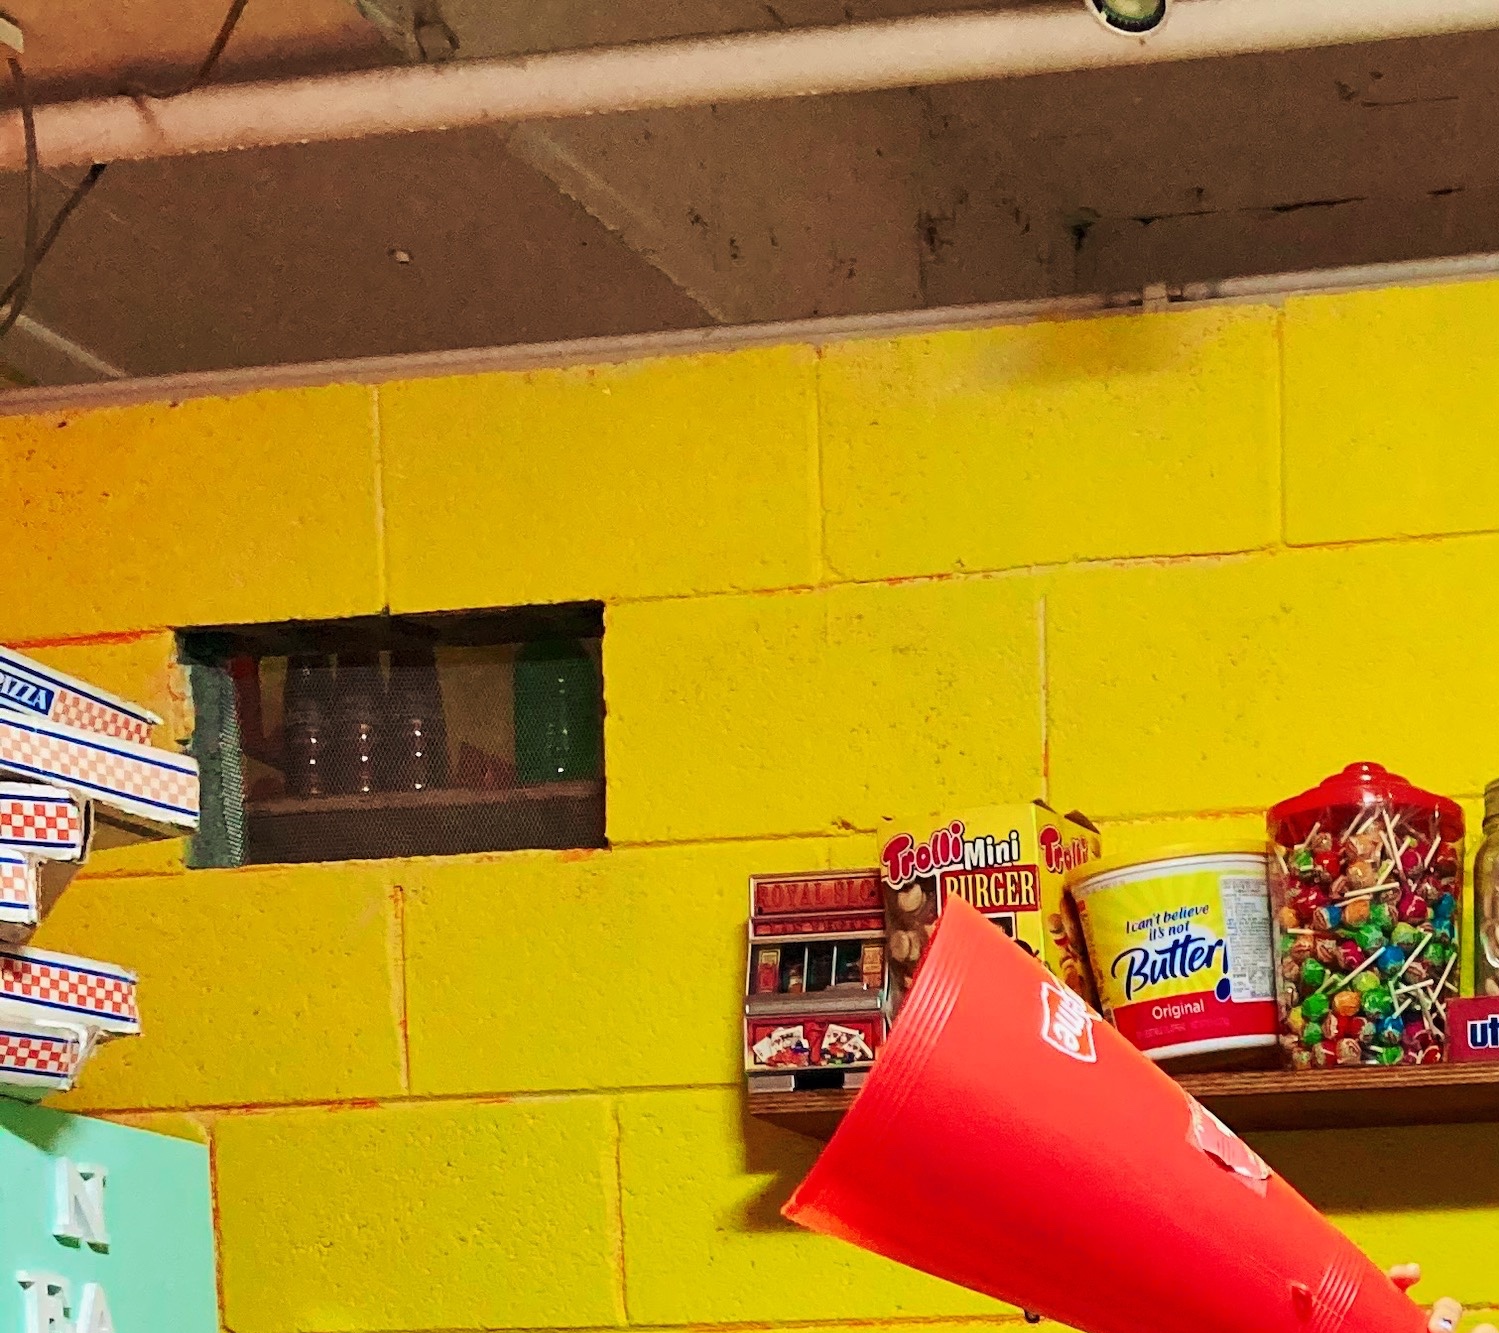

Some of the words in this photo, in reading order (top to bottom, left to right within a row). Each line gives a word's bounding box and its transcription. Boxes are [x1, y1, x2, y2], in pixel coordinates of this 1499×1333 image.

[882, 821, 964, 883] Trolli
[963, 830, 1020, 870] Mini
[1039, 825, 1089, 873] Trolli
[1131, 911, 1161, 933] can't
[1163, 904, 1209, 924] believe
[1168, 921, 1190, 936] not
[1152, 998, 1205, 1020] Original
[53, 1155, 110, 1248] N
